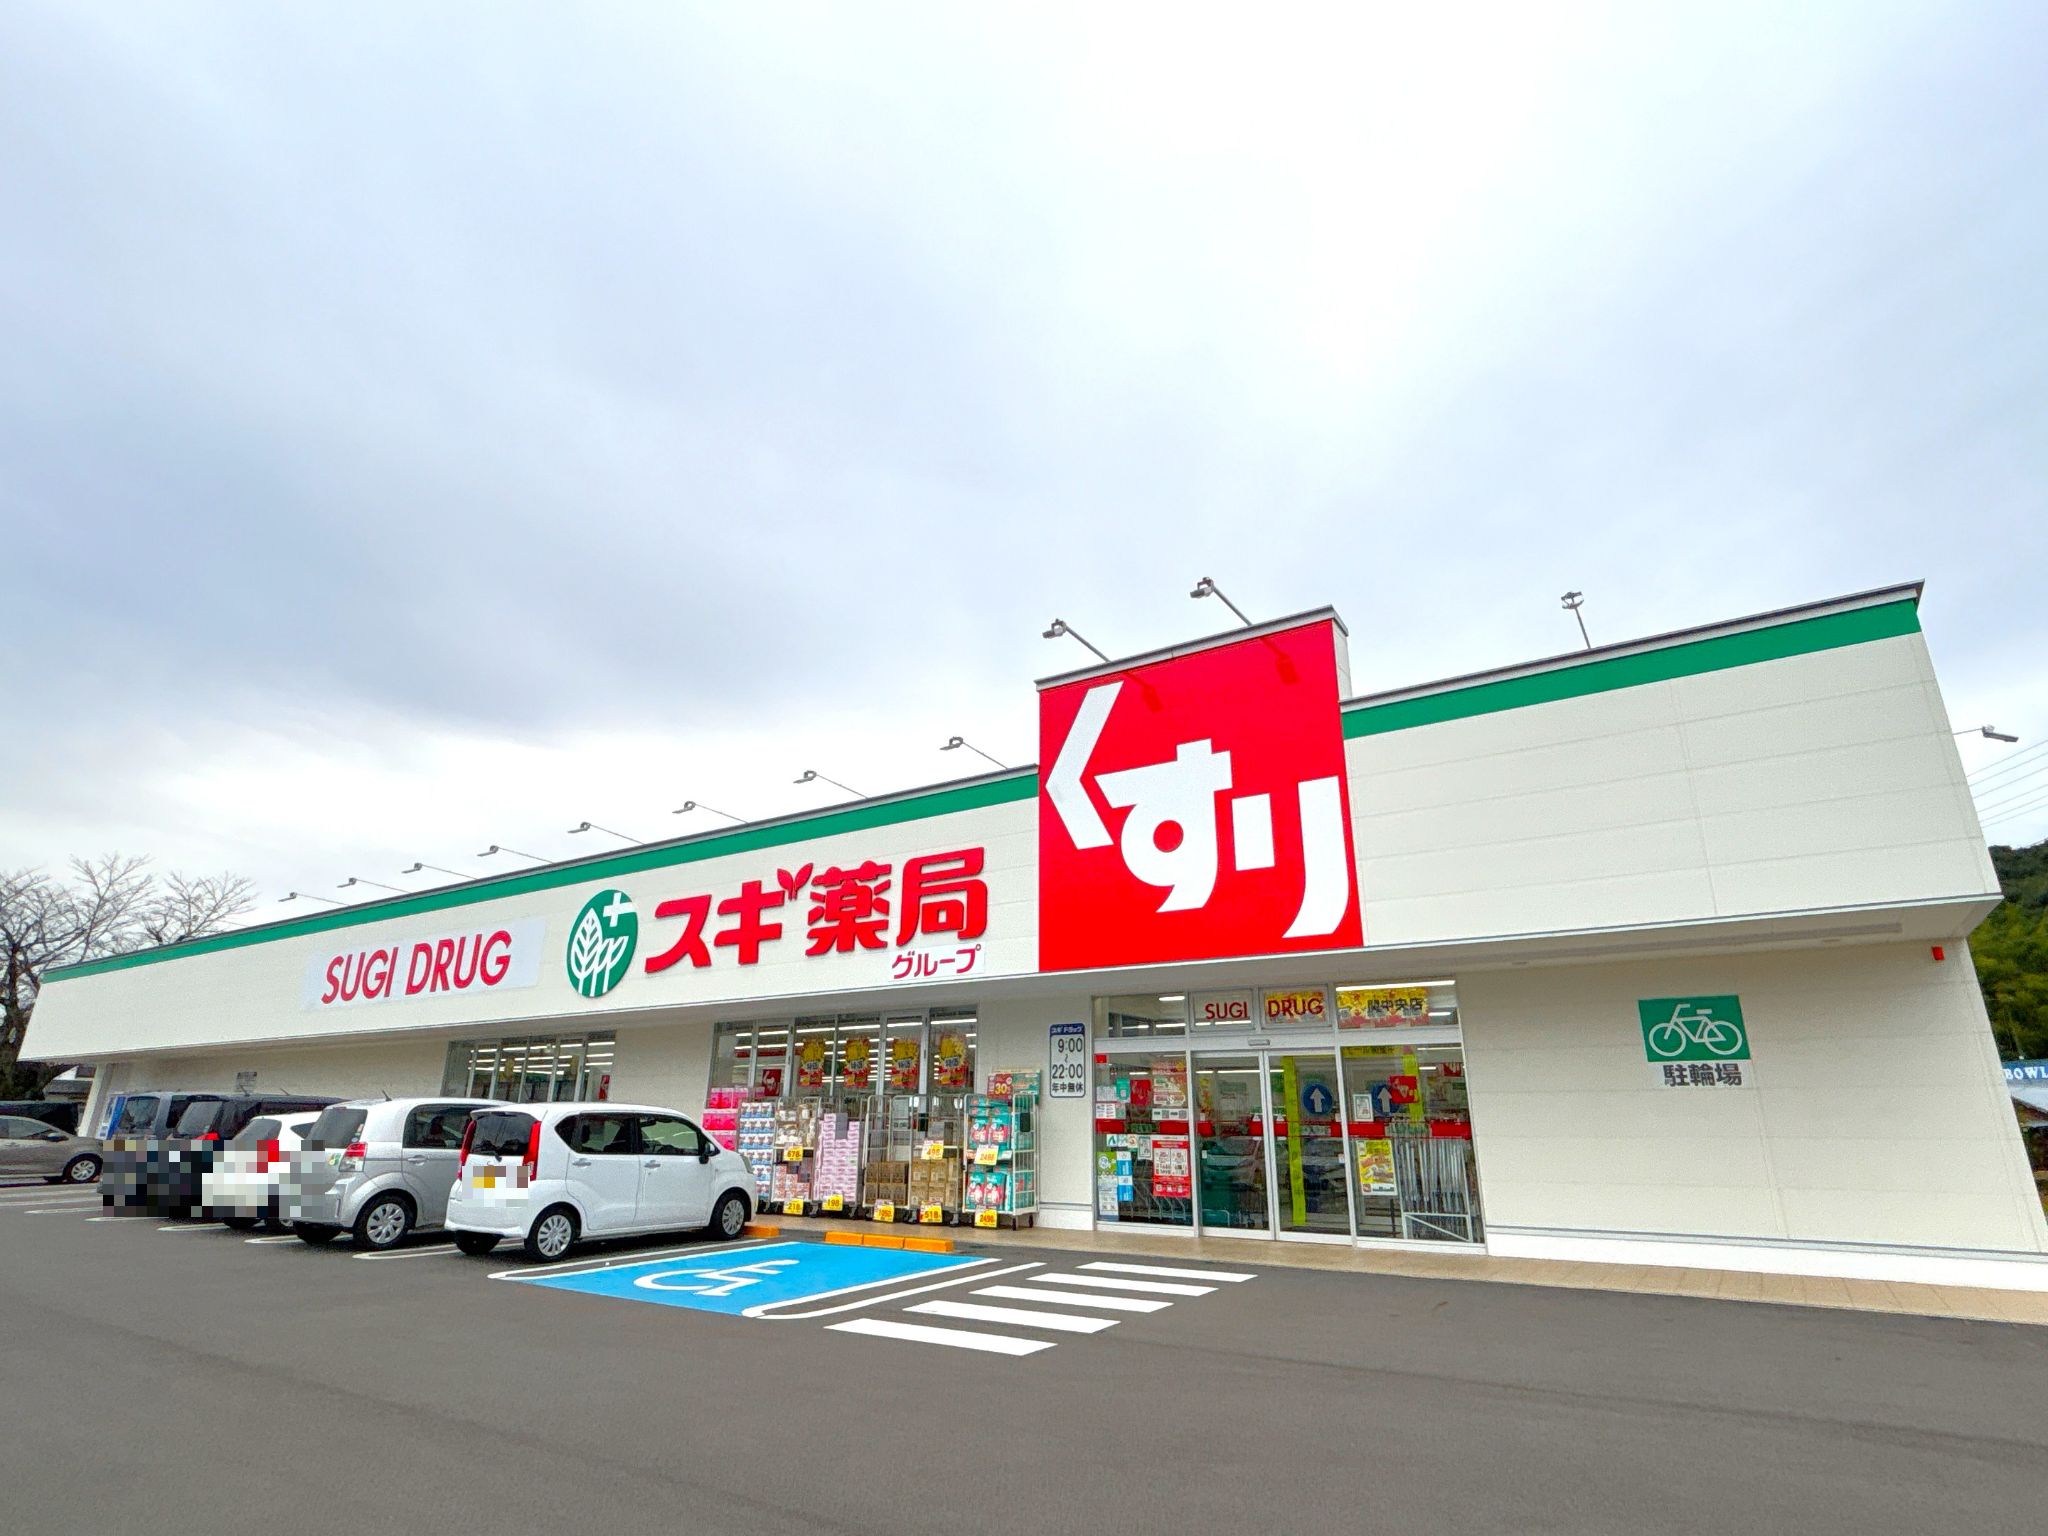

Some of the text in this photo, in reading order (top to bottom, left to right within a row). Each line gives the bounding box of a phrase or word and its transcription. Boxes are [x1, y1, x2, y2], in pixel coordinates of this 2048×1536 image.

[1045, 681, 1349, 938] くすり
[645, 847, 988, 974] スギ薬局
[321, 930, 512, 1005] SUGI DRUG
[891, 944, 981, 979] グループ
[1205, 1001, 1248, 1019] SUGI
[1267, 998, 1324, 1018] DRUG
[1058, 1038, 1083, 1053] 9:00
[1052, 1063, 1083, 1079] 22:00
[1663, 1063, 1742, 1087] 駐輪場
[1051, 1082, 1084, 1093] 年中無休
